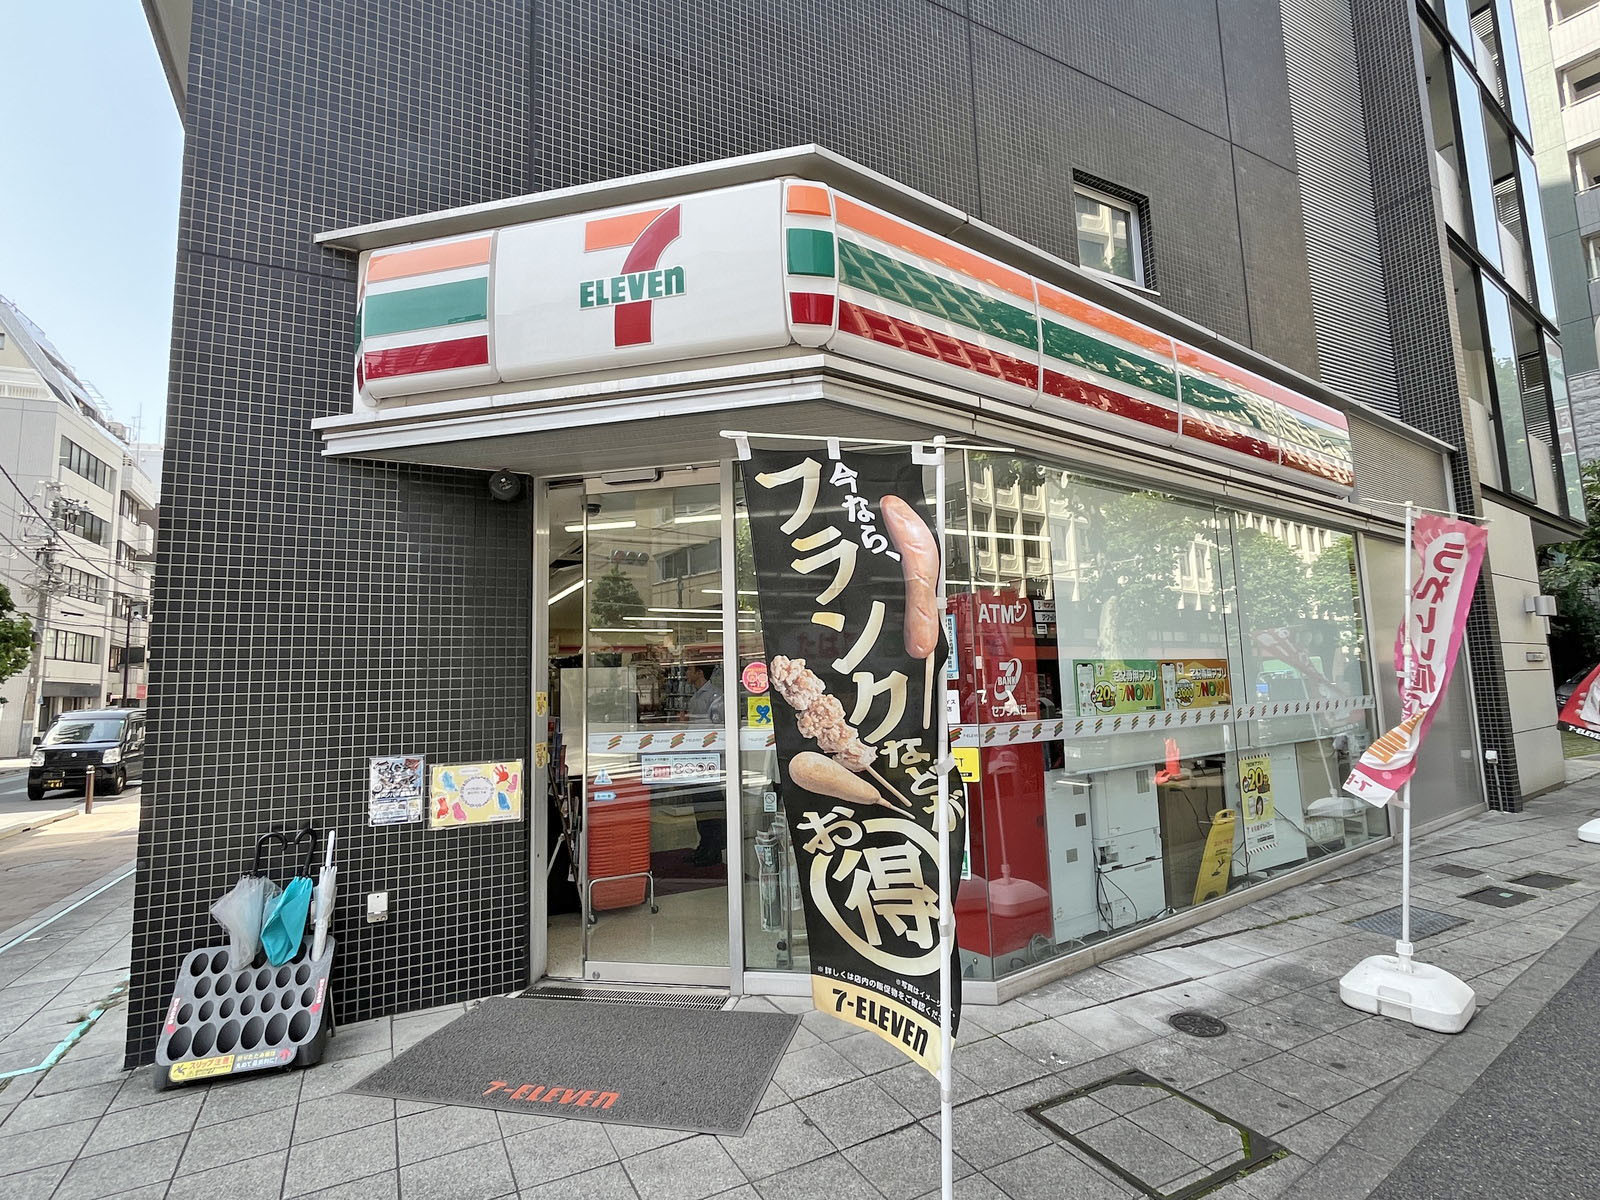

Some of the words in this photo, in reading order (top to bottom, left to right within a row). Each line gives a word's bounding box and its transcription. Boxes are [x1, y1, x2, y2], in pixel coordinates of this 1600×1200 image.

[829, 462, 901, 562] 今なら、
[978, 603, 1015, 624] ATM
[998, 676, 1017, 686] BANK
